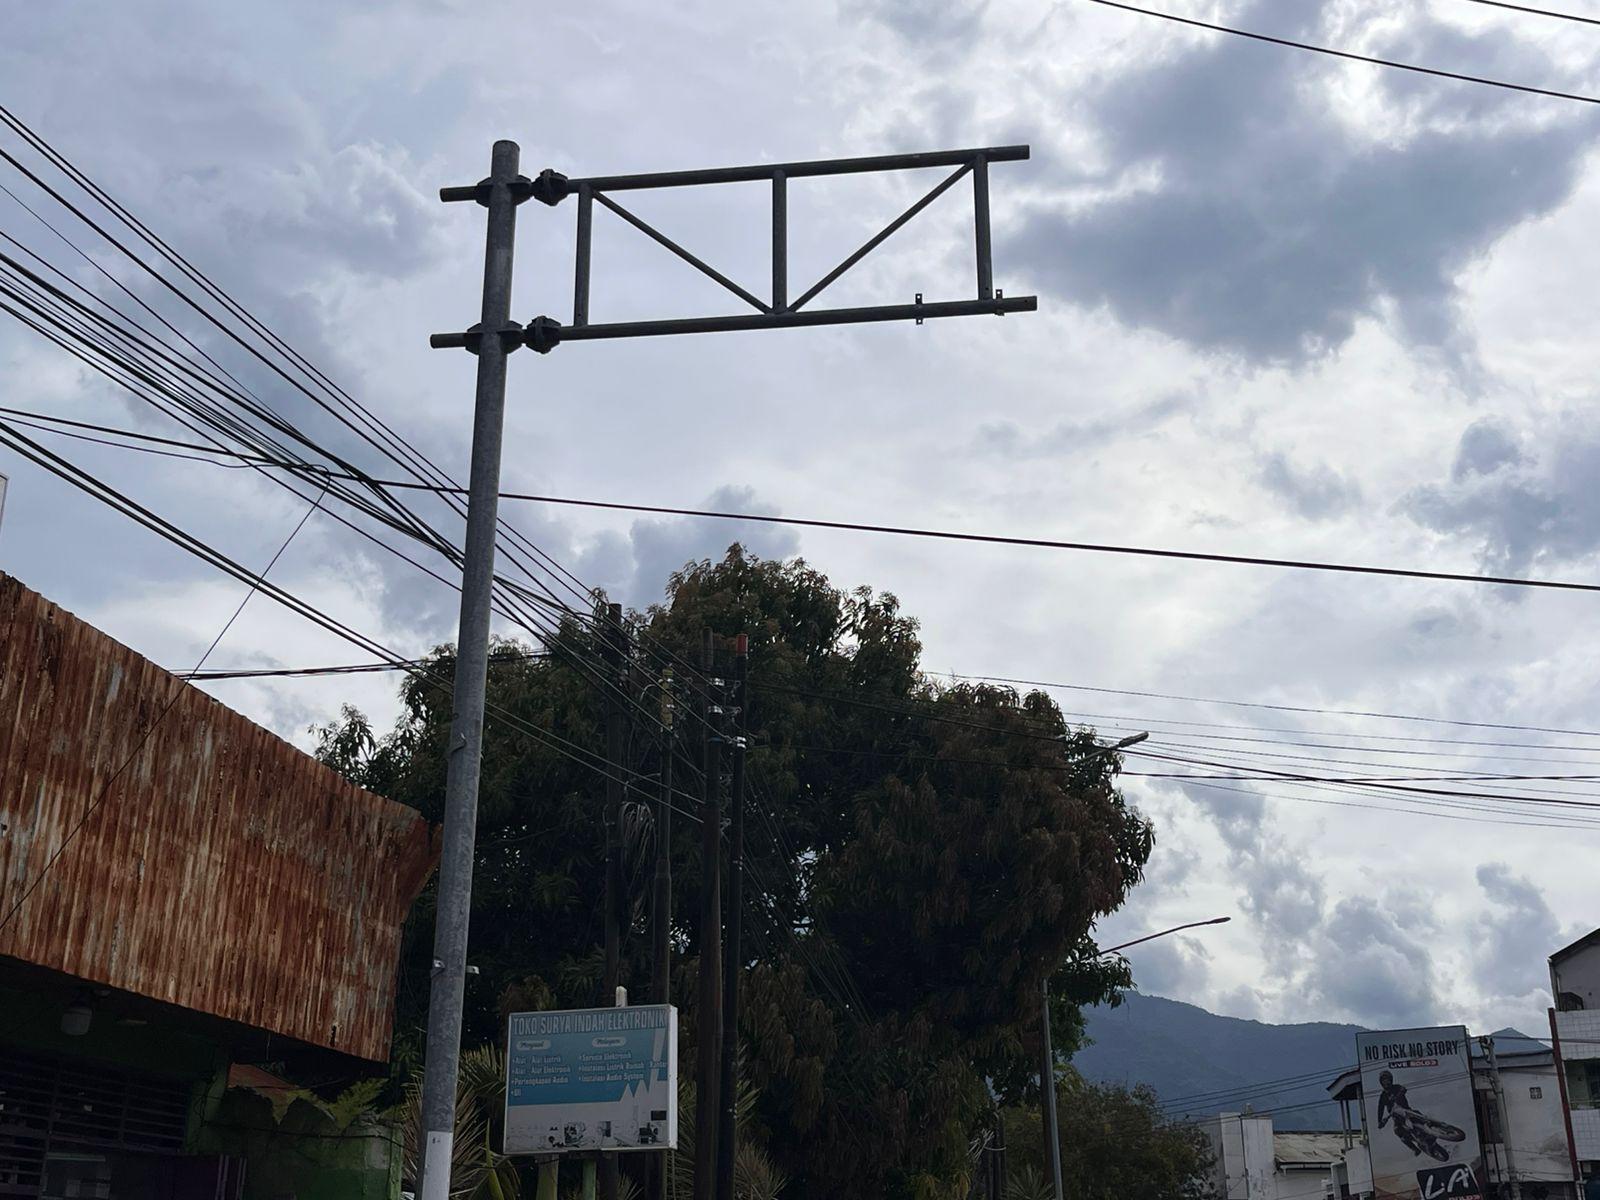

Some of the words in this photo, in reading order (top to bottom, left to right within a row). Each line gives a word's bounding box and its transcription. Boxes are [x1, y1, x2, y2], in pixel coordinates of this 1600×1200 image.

[513, 1017, 537, 1036] TOKO
[541, 1015, 571, 1034] SURYA
[574, 1013, 605, 1033] INDAH
[608, 1010, 666, 1031] ELEKTRONIK
[1365, 1045, 1379, 1060] NO
[1382, 1043, 1407, 1059] RISK
[1409, 1042, 1423, 1057] NO
[1426, 1040, 1459, 1056] STORY
